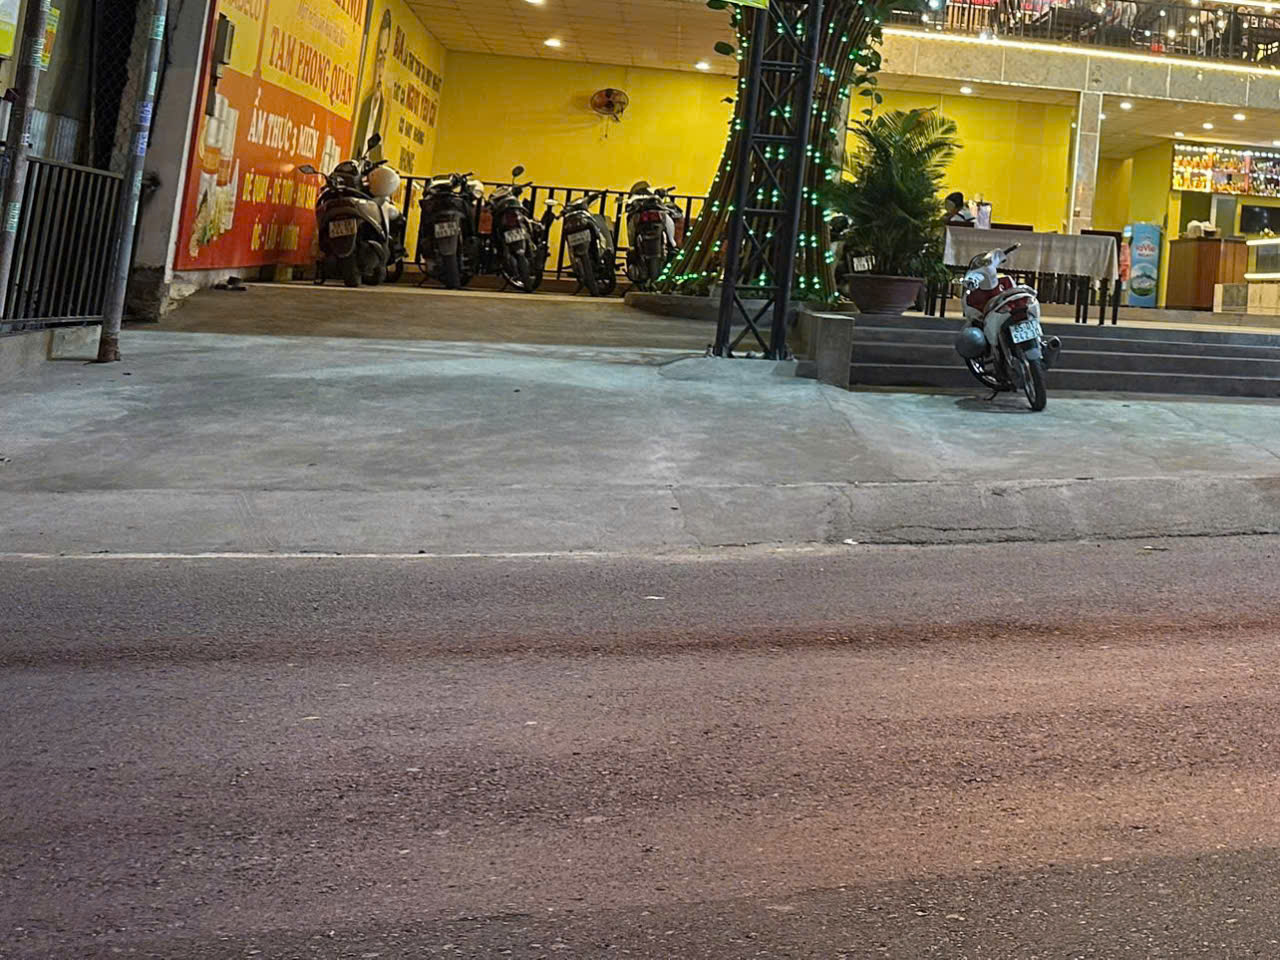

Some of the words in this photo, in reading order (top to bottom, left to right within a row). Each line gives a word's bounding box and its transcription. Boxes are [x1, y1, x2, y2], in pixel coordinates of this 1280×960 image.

[295, 43, 331, 93] PHONG
[329, 61, 355, 106] QUÁN
[265, 114, 293, 159] THỰC
[290, 126, 299, 158] 3
